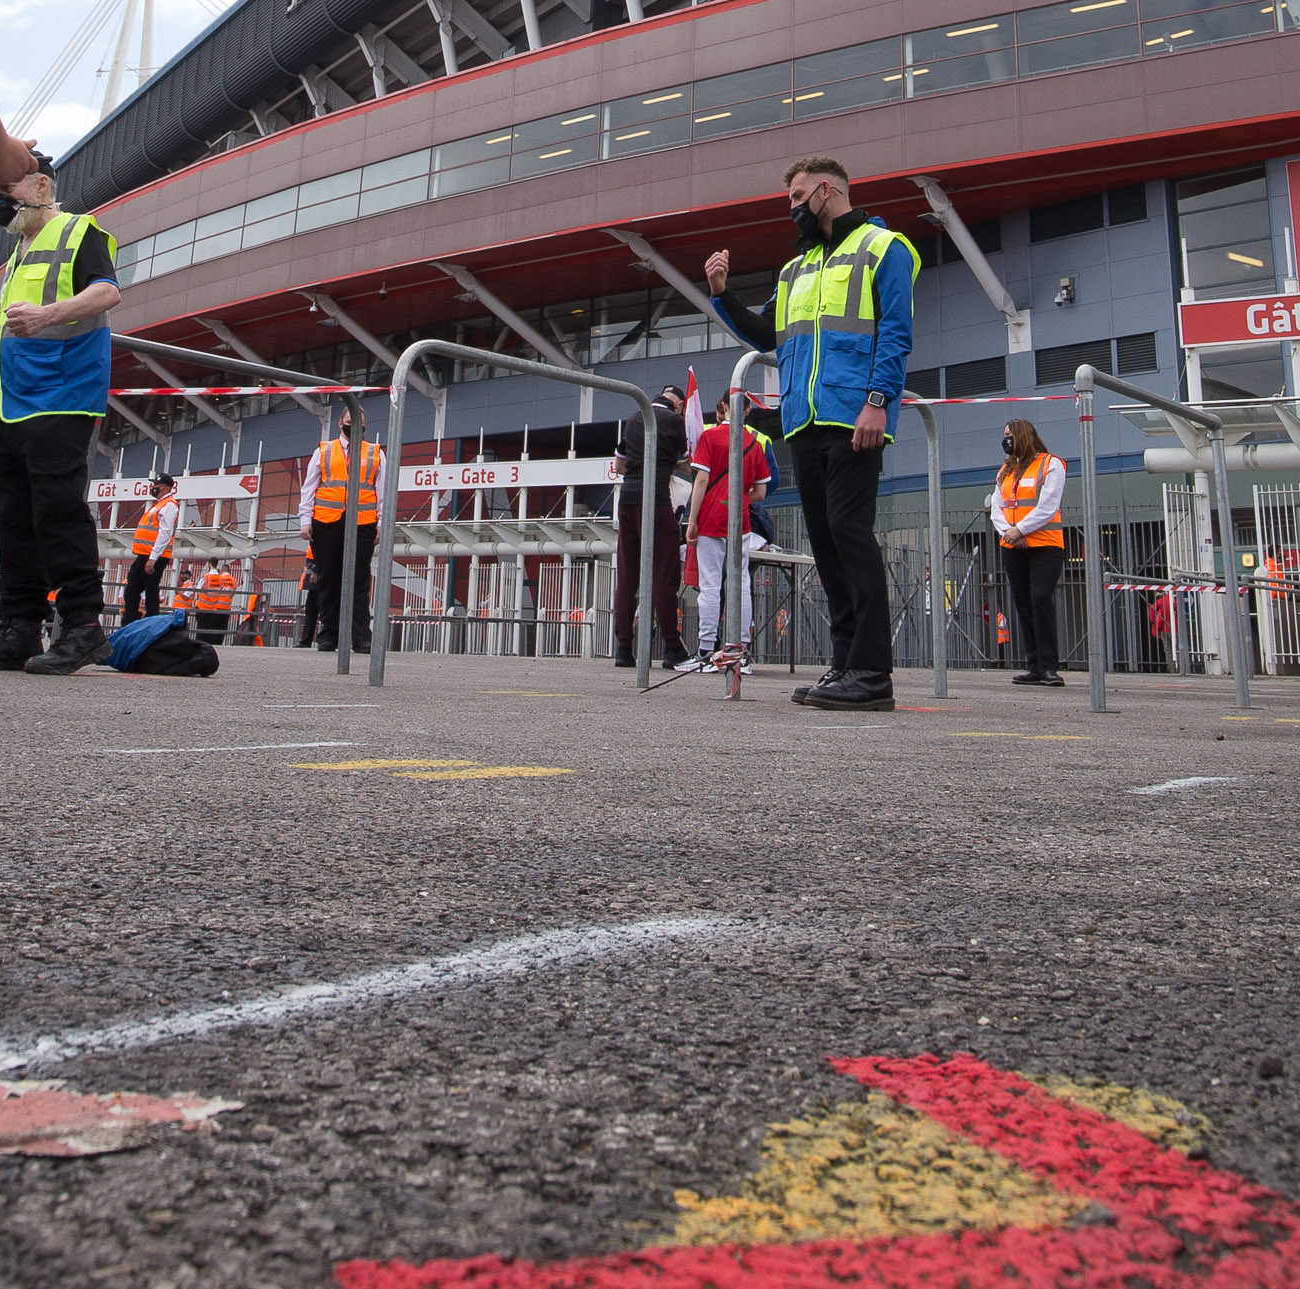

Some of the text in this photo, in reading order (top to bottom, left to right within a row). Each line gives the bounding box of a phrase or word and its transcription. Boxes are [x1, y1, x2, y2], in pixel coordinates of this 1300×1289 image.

[414, 469, 439, 486] Gât
[461, 467, 496, 485] Gate
[510, 466, 519, 483] 3
[97, 482, 117, 497] Gât
[134, 481, 155, 496] Gat
